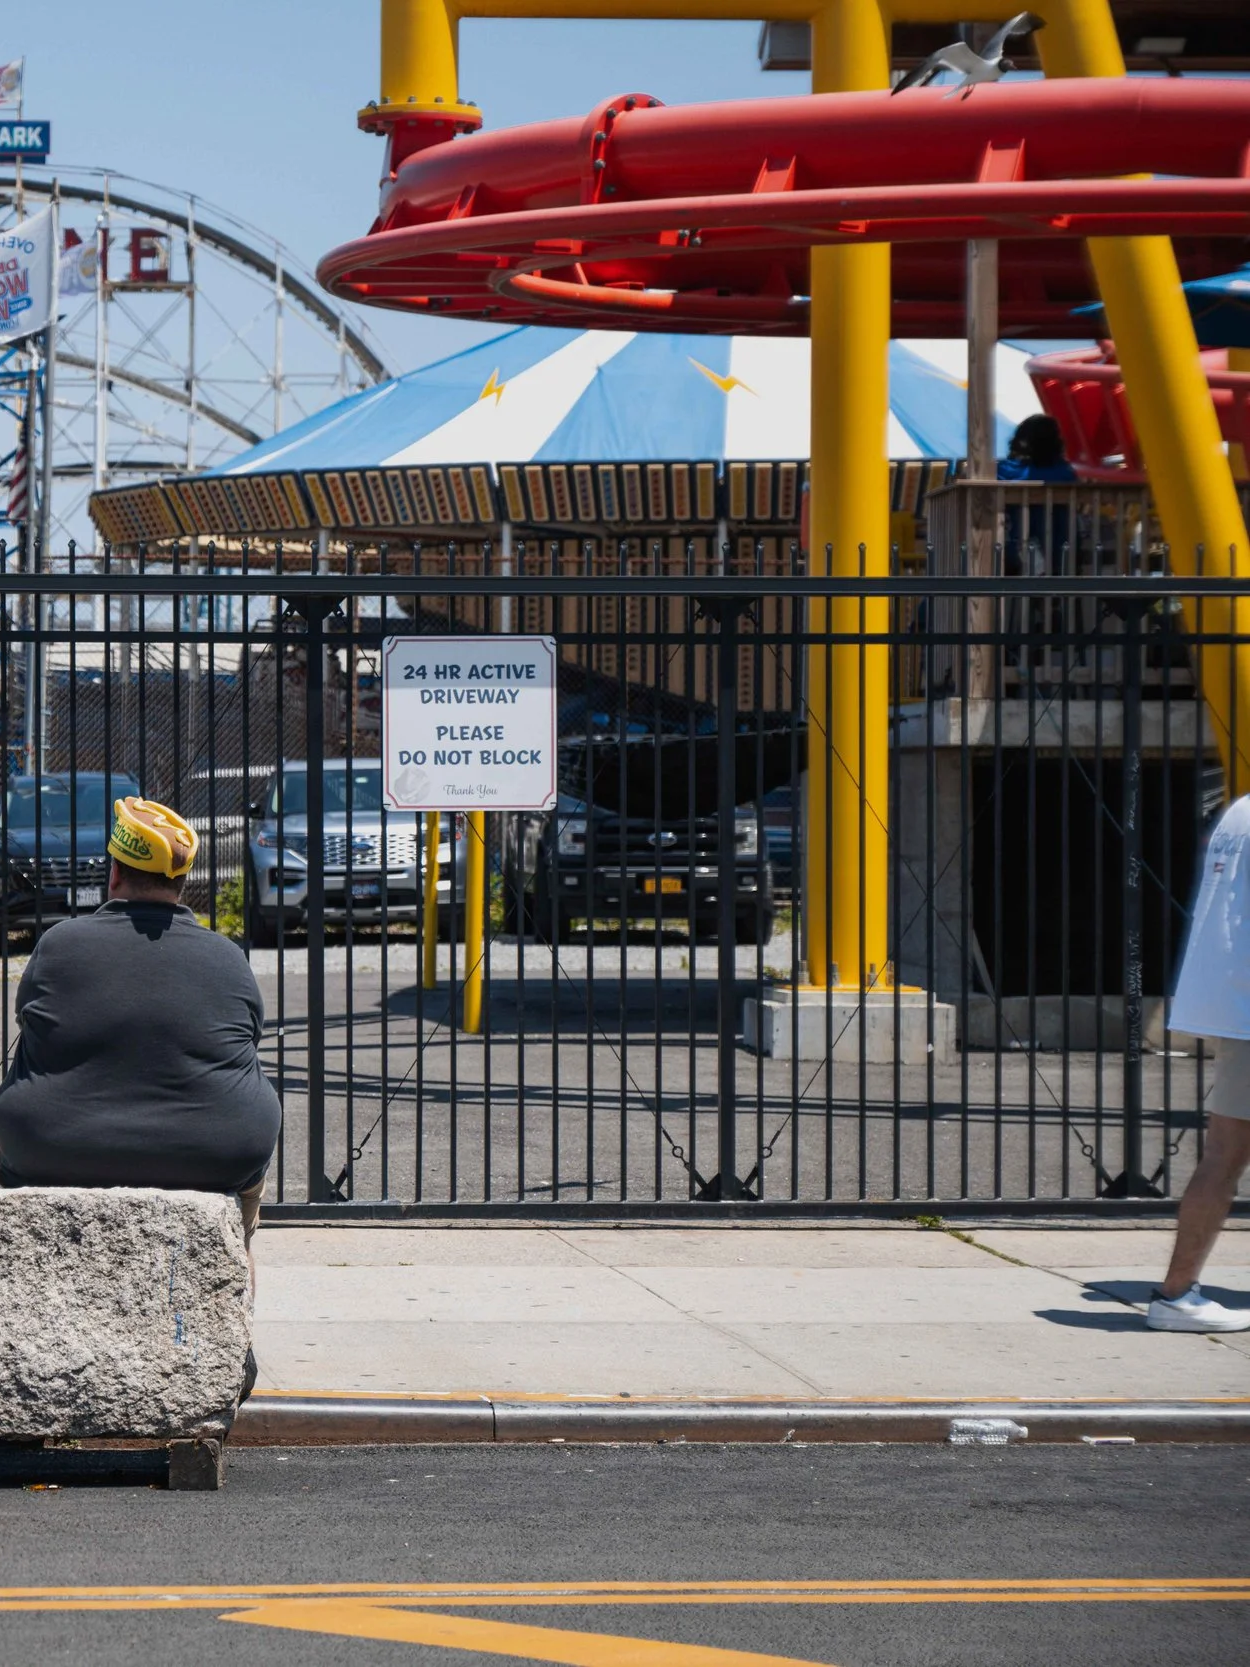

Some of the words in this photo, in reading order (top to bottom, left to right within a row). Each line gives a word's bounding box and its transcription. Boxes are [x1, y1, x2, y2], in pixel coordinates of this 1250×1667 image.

[403, 664, 427, 680] 24
[434, 664, 461, 680] HR
[467, 664, 536, 680] ACTIVE
[420, 689, 520, 705] DRIVEWAY
[436, 725, 504, 740] PLEASE
[398, 750, 427, 766] DO
[434, 750, 472, 765] NOT
[480, 750, 542, 765] BLOCK
[443, 784, 474, 796] Thank
[477, 784, 498, 798] You
